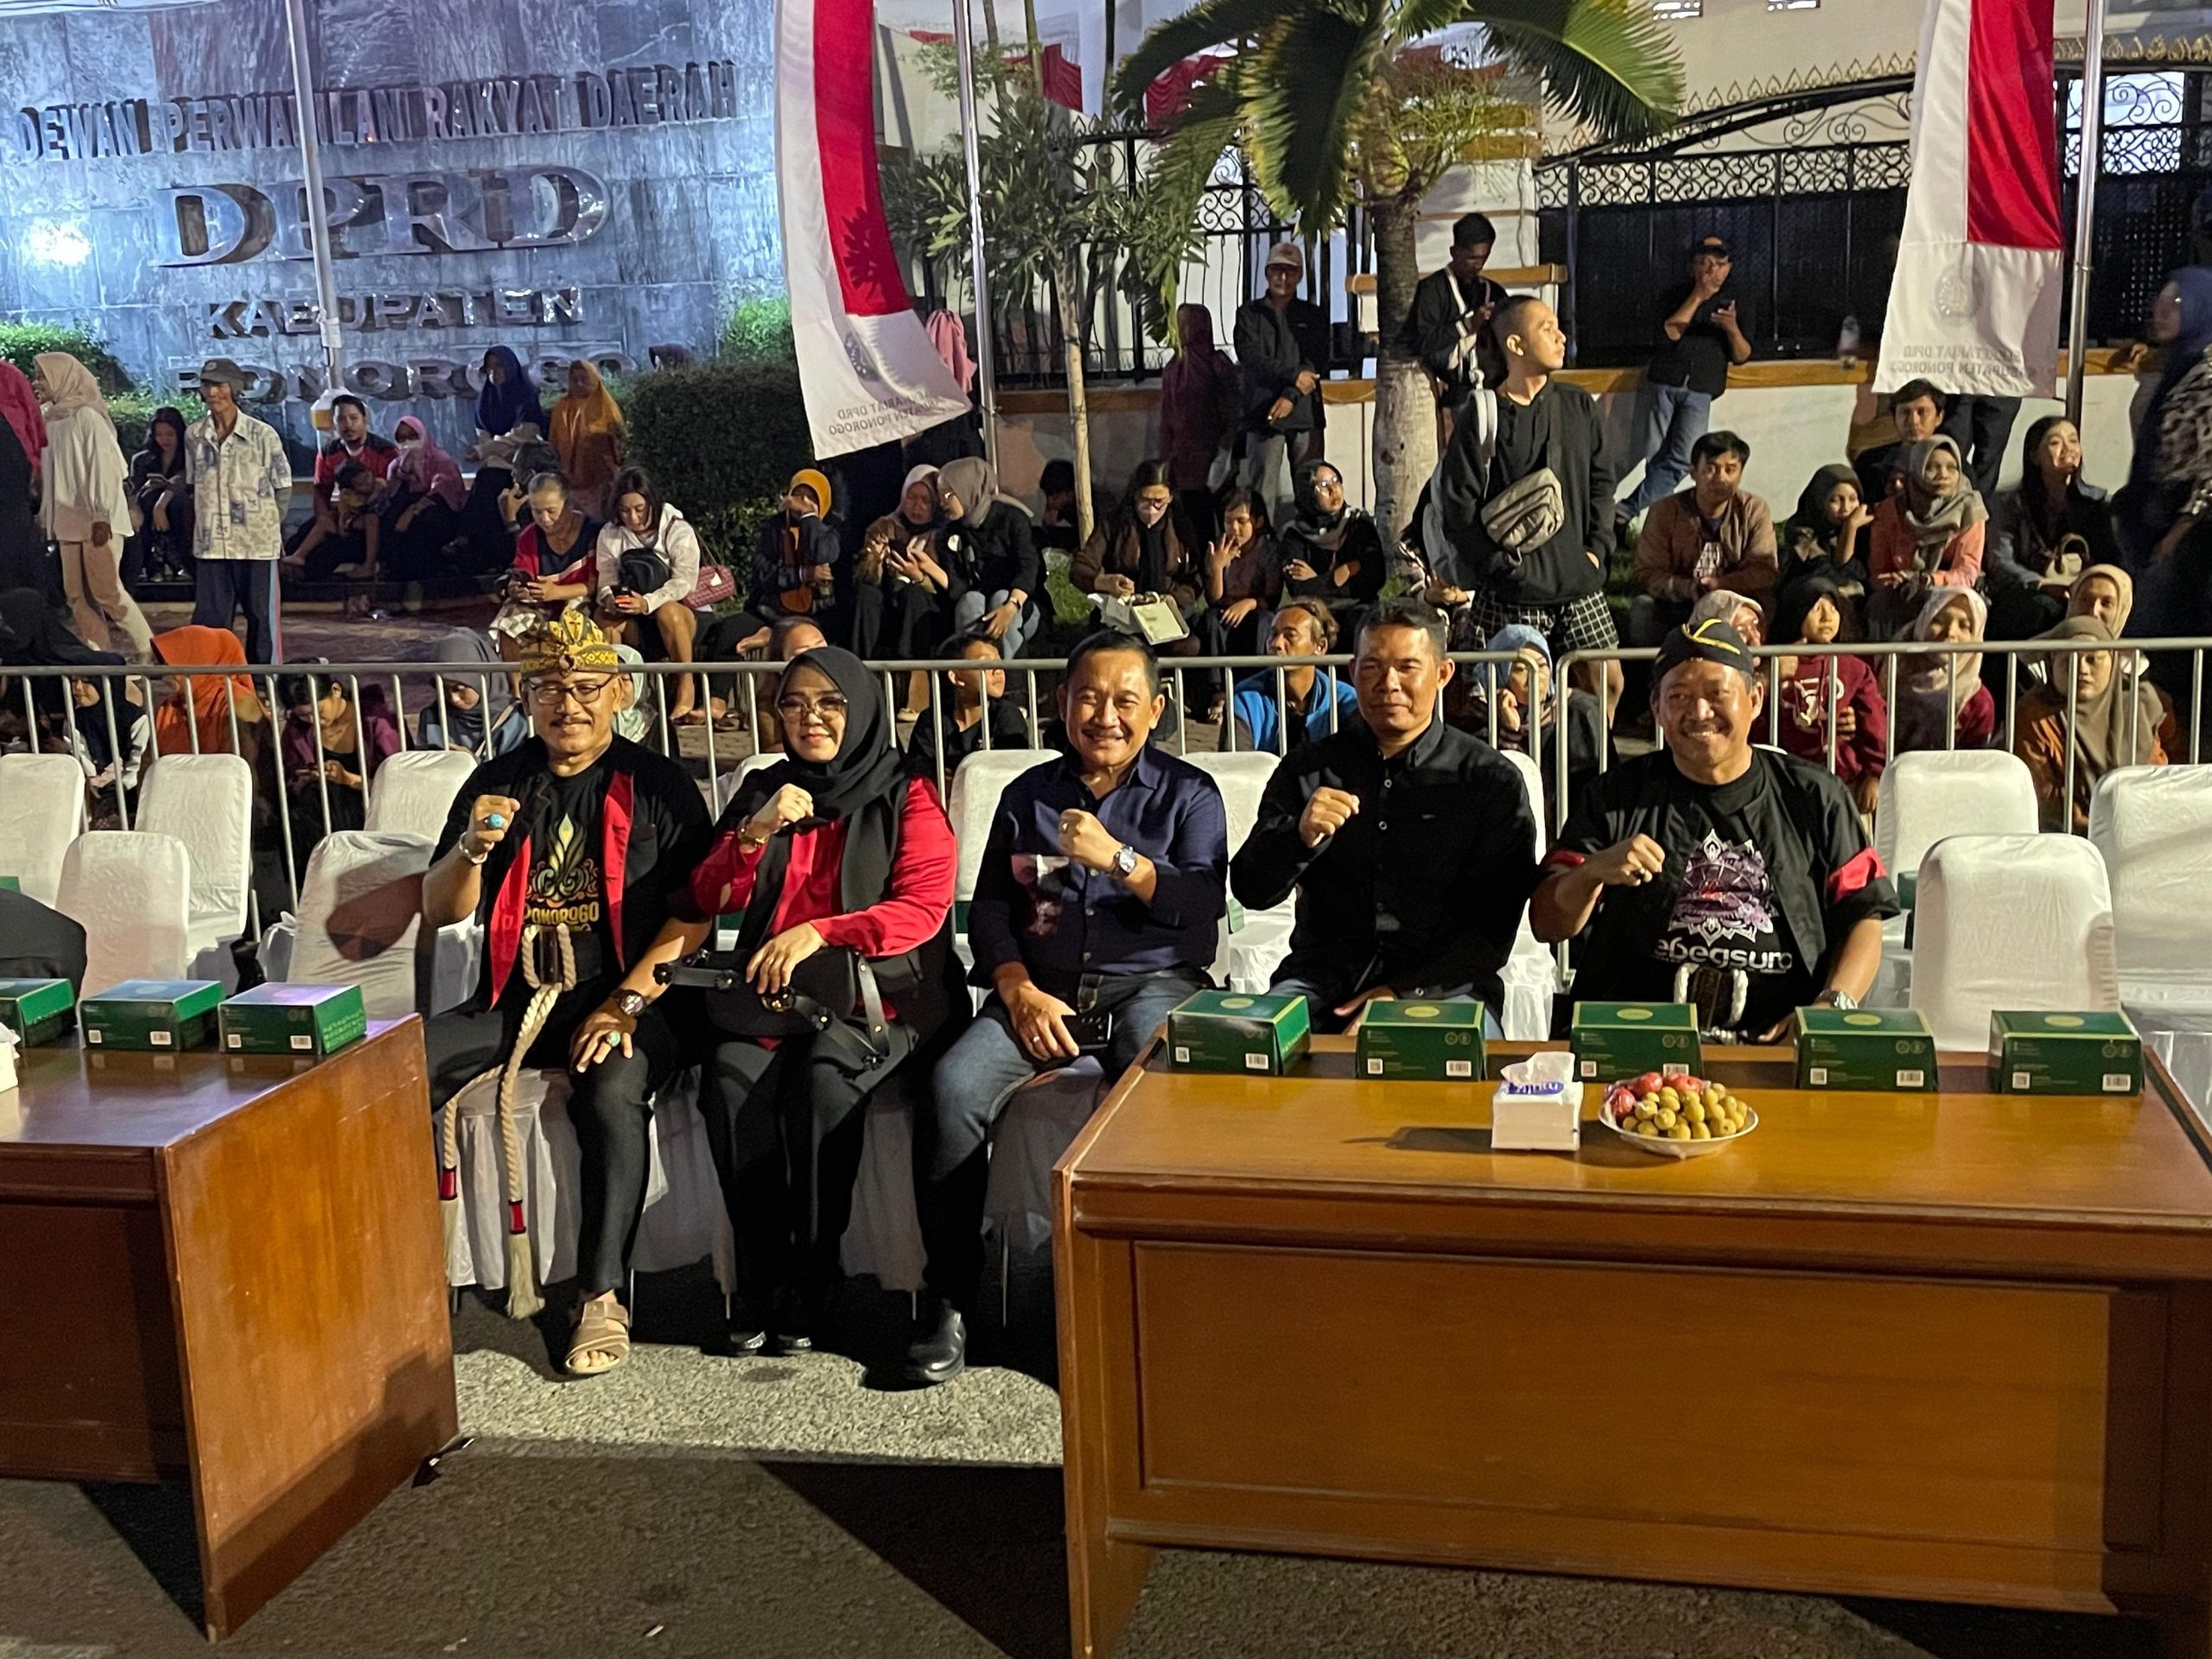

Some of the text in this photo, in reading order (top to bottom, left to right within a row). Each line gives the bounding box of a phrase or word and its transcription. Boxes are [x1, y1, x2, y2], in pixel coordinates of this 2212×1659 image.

[14, 99, 143, 164] DEWAN
[424, 76, 572, 138] RAKYAT
[587, 63, 737, 129] DAERAH
[150, 165, 610, 266] DPRD
[207, 285, 585, 337] KABUPATEN
